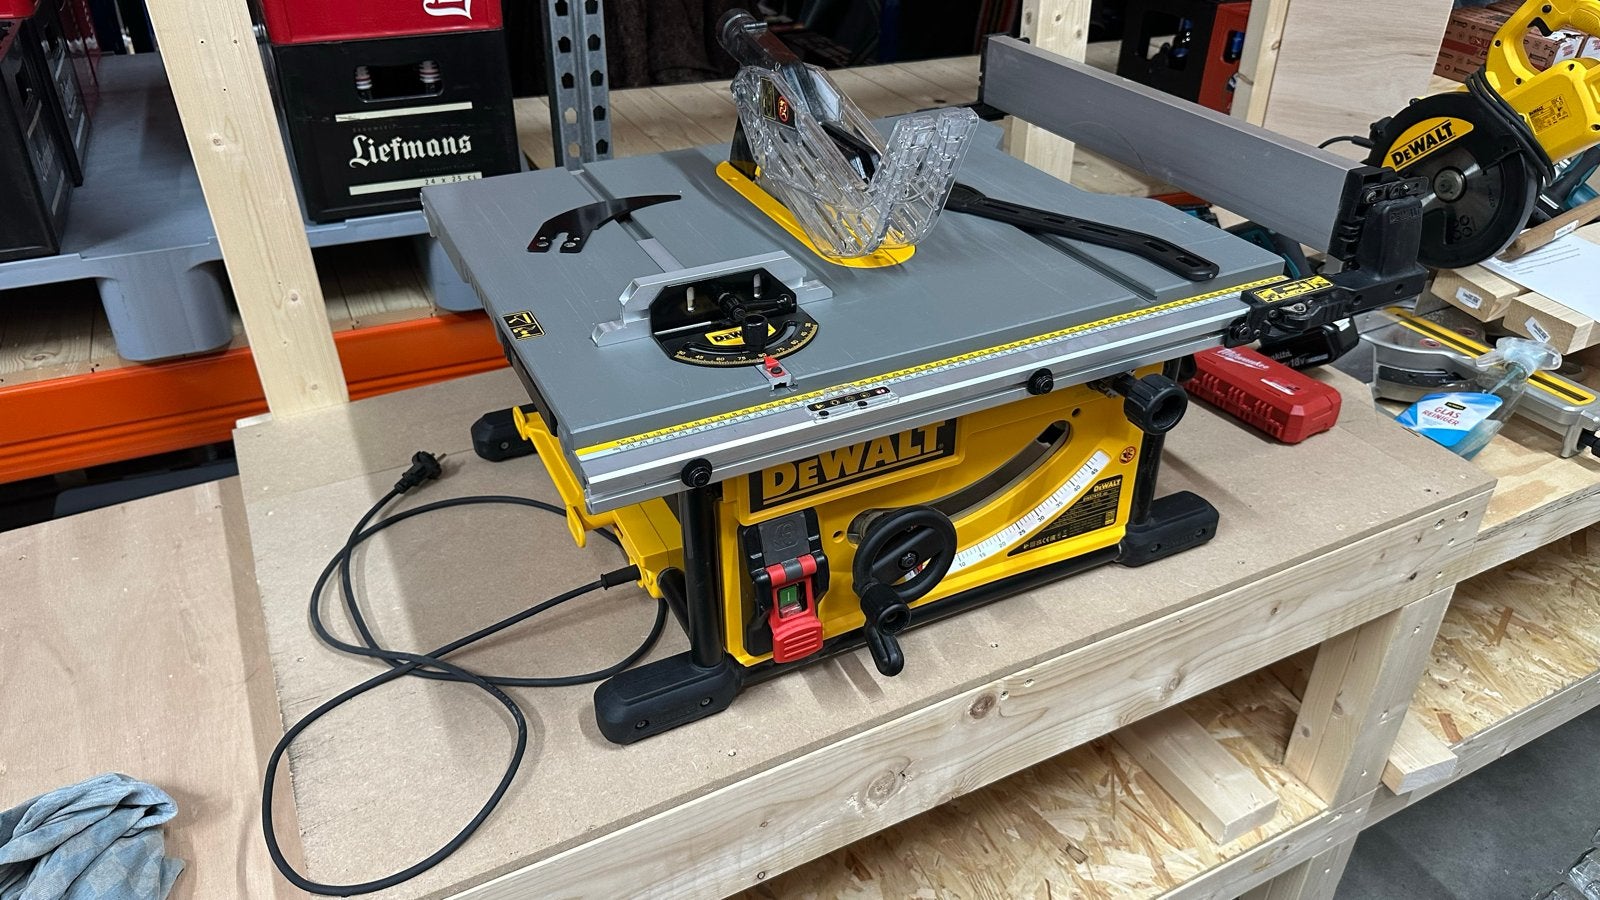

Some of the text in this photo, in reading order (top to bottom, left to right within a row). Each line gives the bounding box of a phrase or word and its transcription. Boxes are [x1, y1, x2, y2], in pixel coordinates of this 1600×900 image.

[350, 134, 472, 168] Liefmans
[1391, 122, 1454, 167] DEWALT
[713, 331, 742, 343] DEW
[1422, 409, 1459, 426] REINIGER
[1434, 406, 1461, 419] GLAS
[762, 421, 944, 500] DEWALT
[1074, 484, 1081, 492] 40
